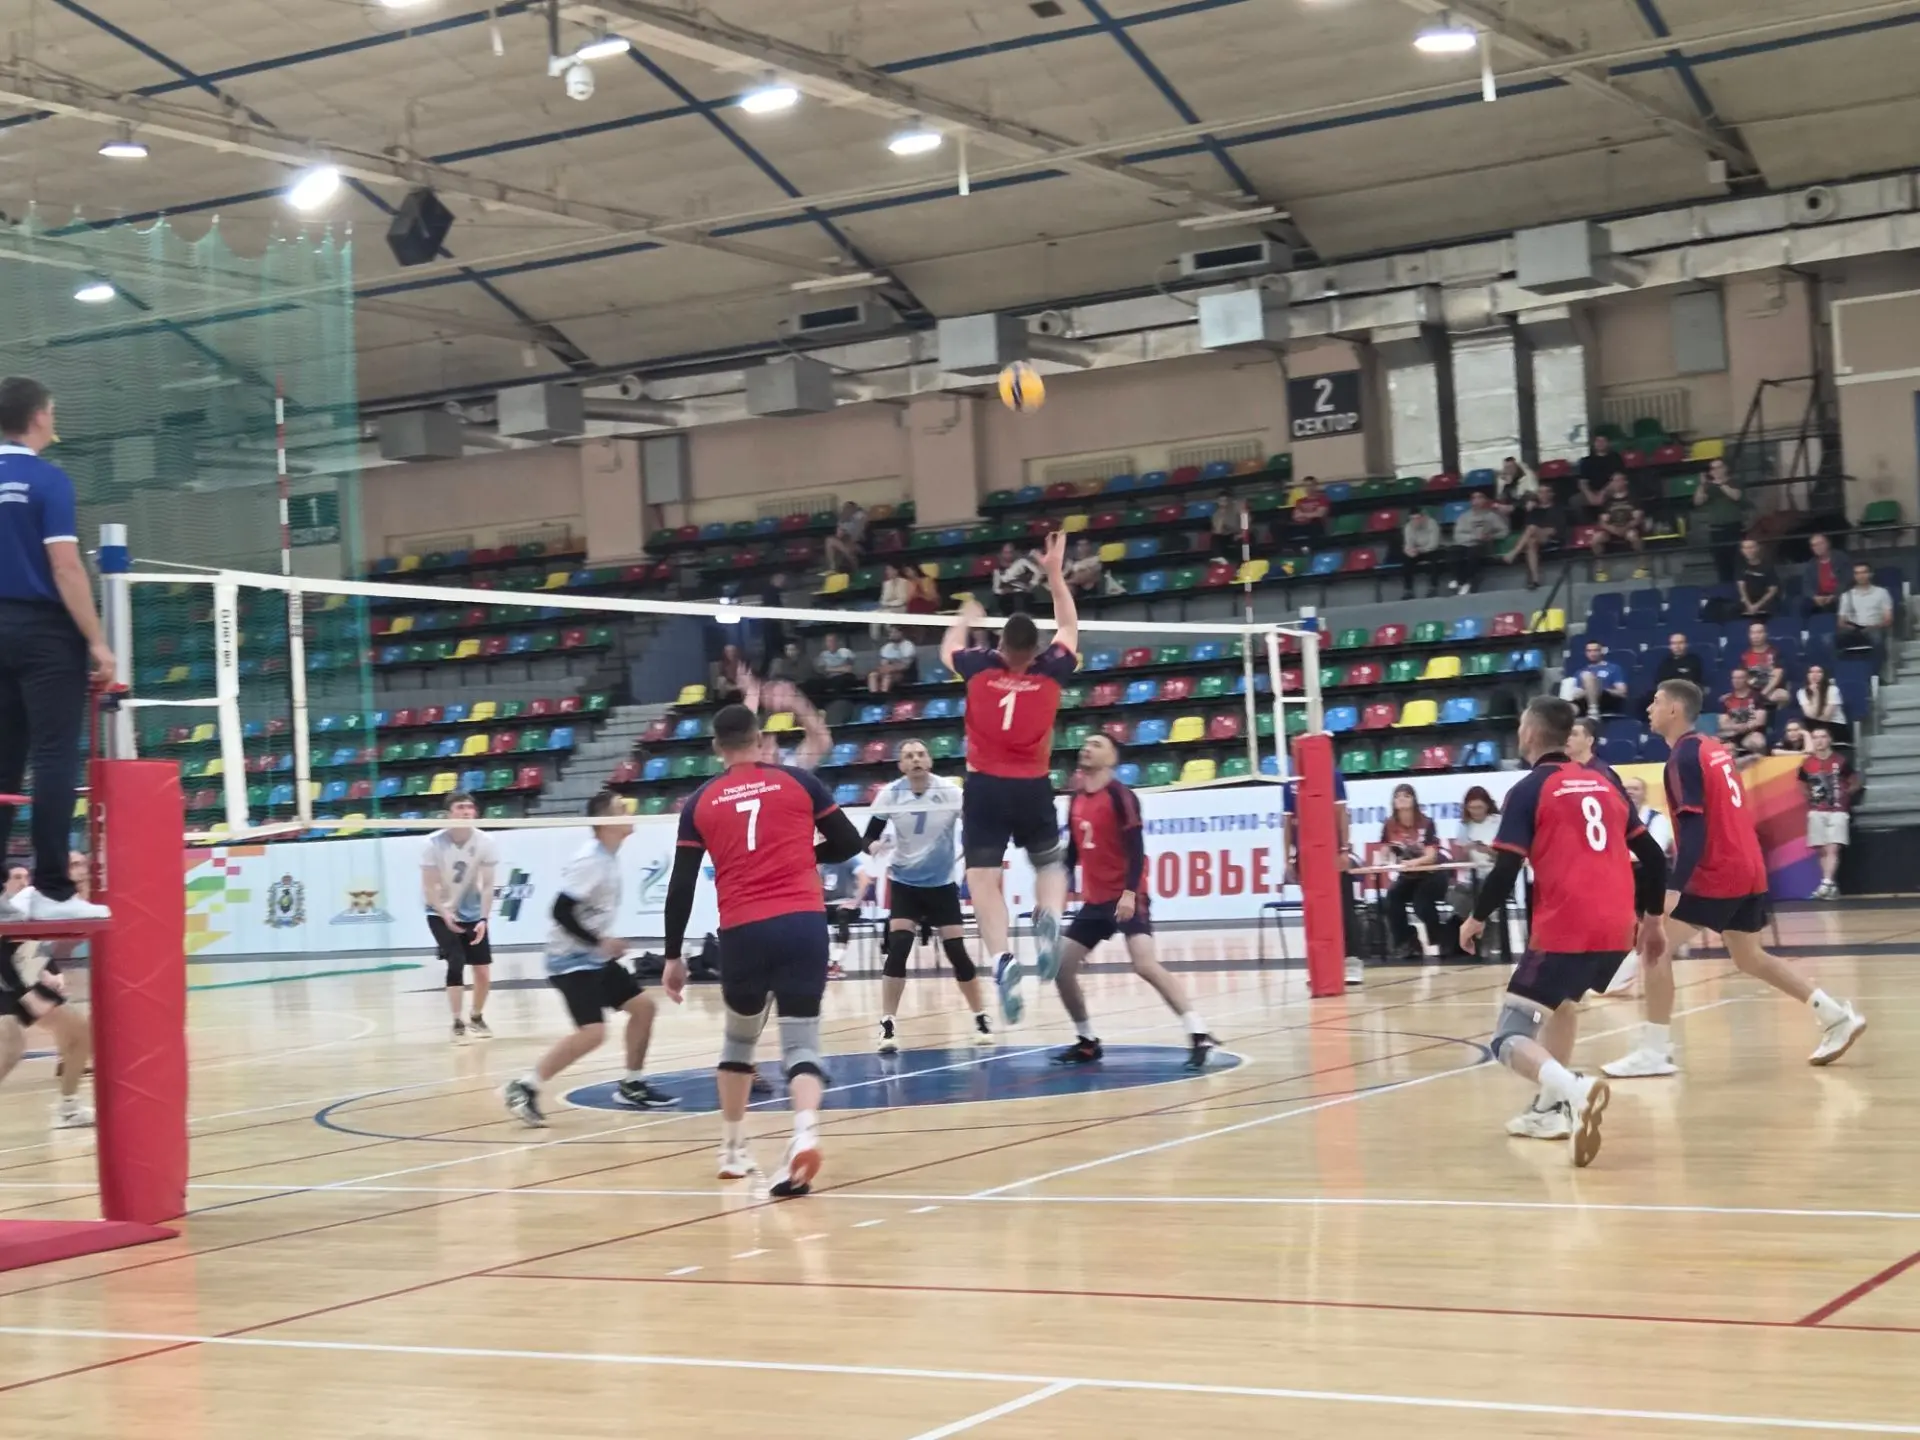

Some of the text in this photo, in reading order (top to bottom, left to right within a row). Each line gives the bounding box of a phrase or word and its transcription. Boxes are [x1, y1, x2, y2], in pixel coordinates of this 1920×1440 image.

[1313, 378, 1335, 412] 2
[1293, 412, 1358, 436] СЕКТОР
[998, 689, 1017, 731] 1
[1721, 763, 1742, 808] 5
[735, 798, 760, 852] 7
[910, 810, 927, 835] 7
[1079, 820, 1097, 849] 2
[1581, 795, 1607, 852] 8
